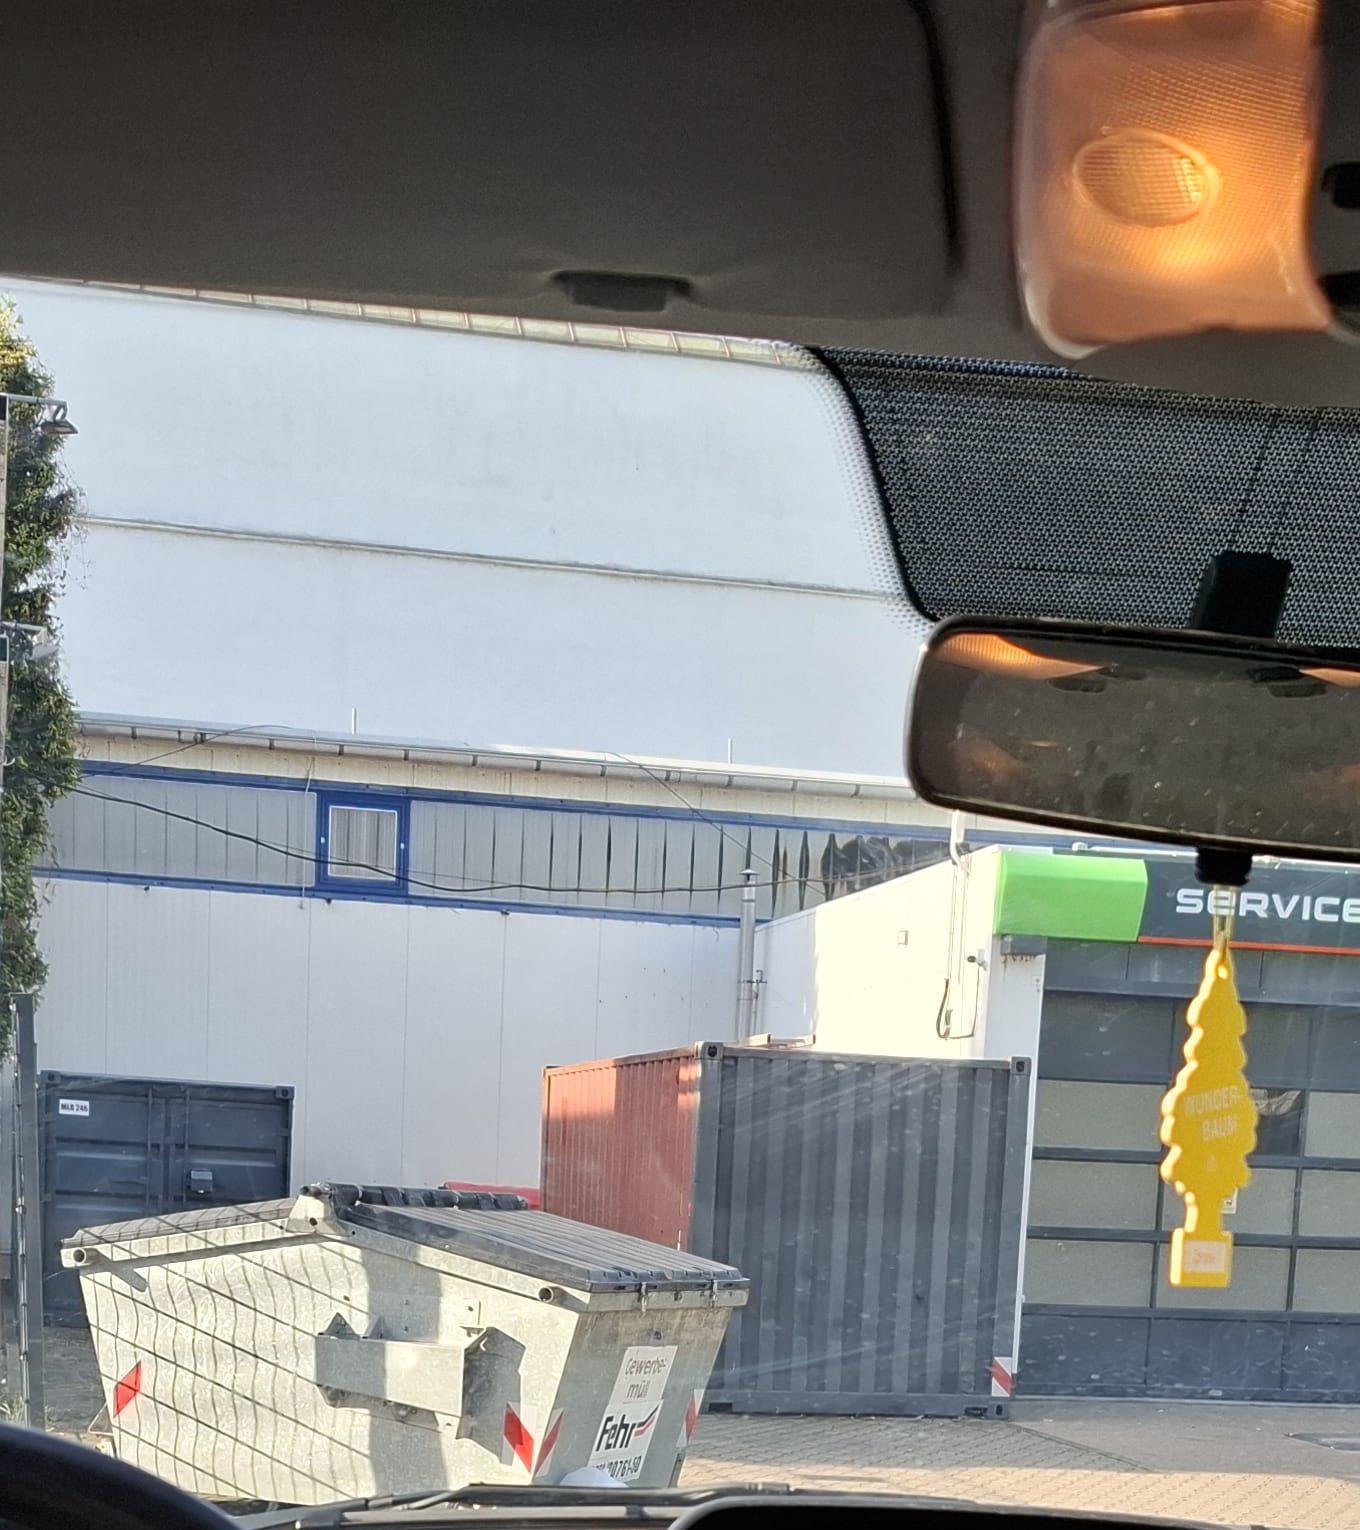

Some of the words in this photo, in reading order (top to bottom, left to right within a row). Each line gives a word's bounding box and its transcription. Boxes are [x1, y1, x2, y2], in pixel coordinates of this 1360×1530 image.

[1184, 1085, 1239, 1114] WUNDER
[1203, 1113, 1238, 1140] BAUM
[596, 1414, 636, 1452] Fehr
